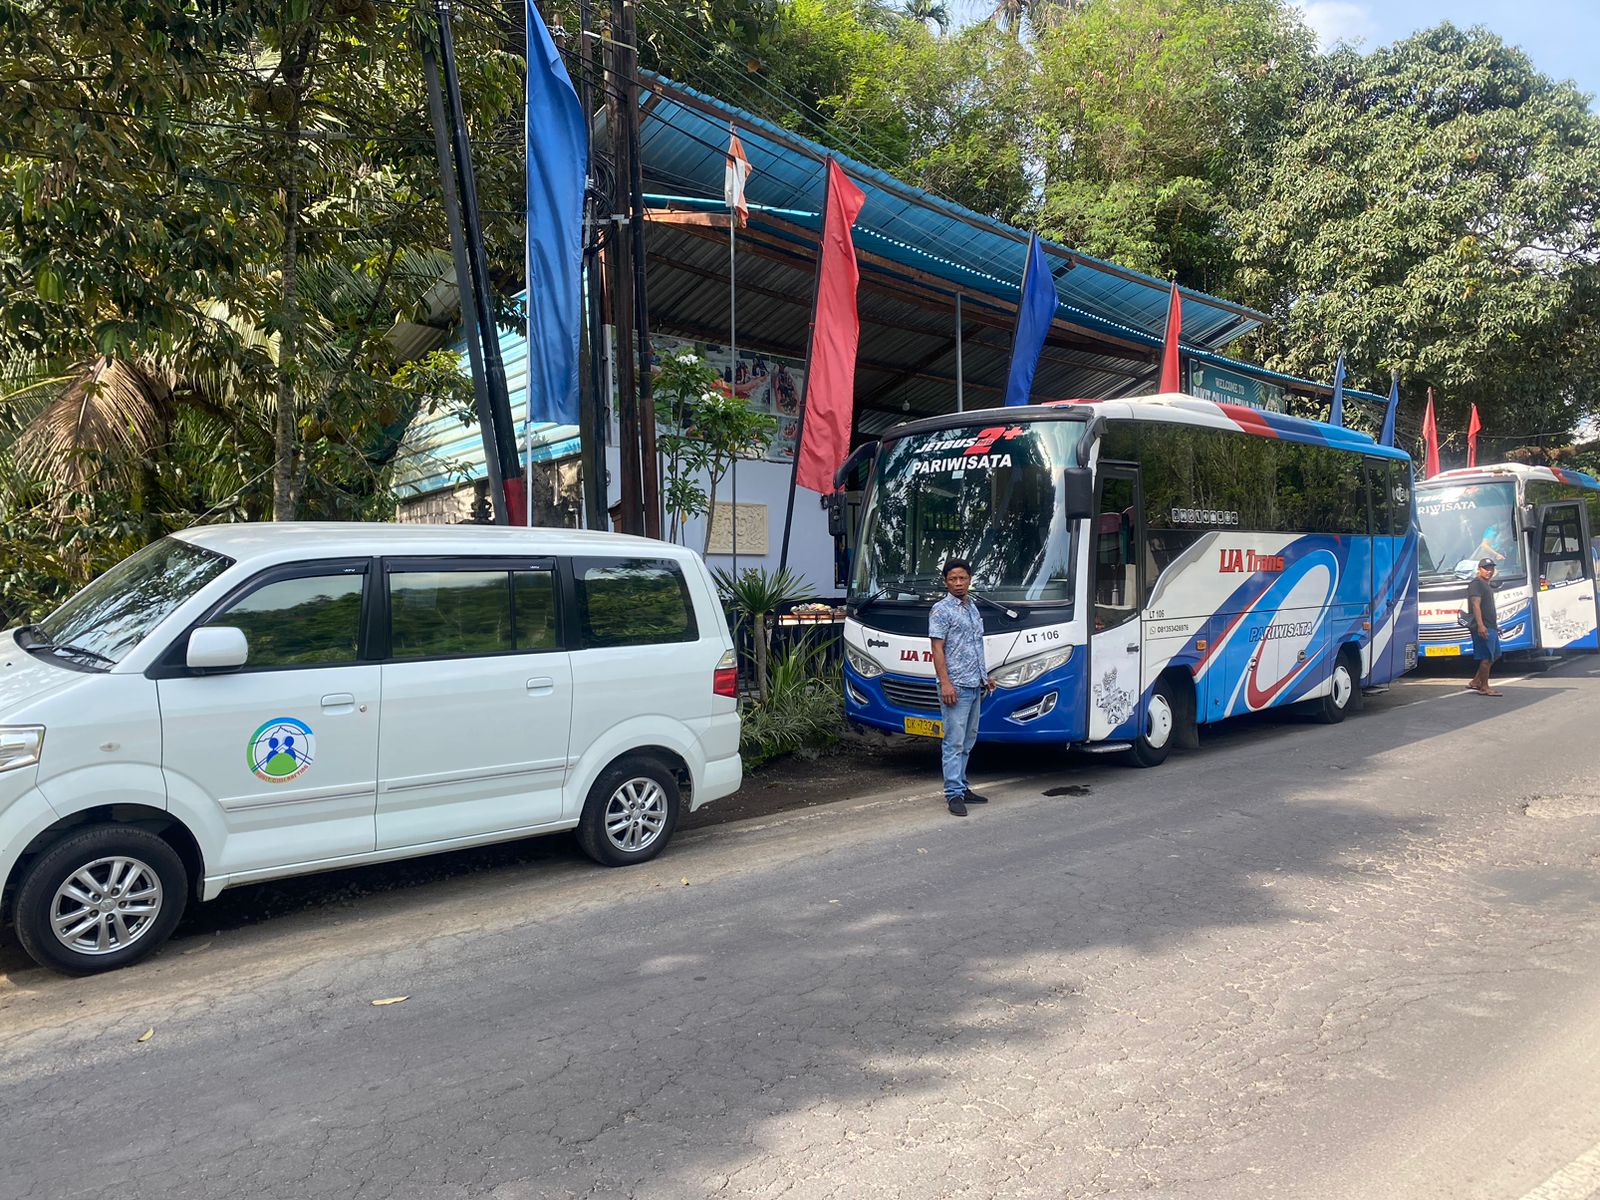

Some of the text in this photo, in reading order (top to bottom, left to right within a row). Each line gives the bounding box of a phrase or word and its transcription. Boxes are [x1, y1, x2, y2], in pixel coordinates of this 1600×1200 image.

[913, 437, 978, 454] JETBUS
[912, 453, 1012, 475] PARIWISATA
[1219, 548, 1285, 573] LIA Trans
[1149, 610, 1156, 619] LT
[1026, 630, 1060, 644] LT 106
[1249, 621, 1313, 643] PARIWISATA
[900, 650, 919, 662] LIA
